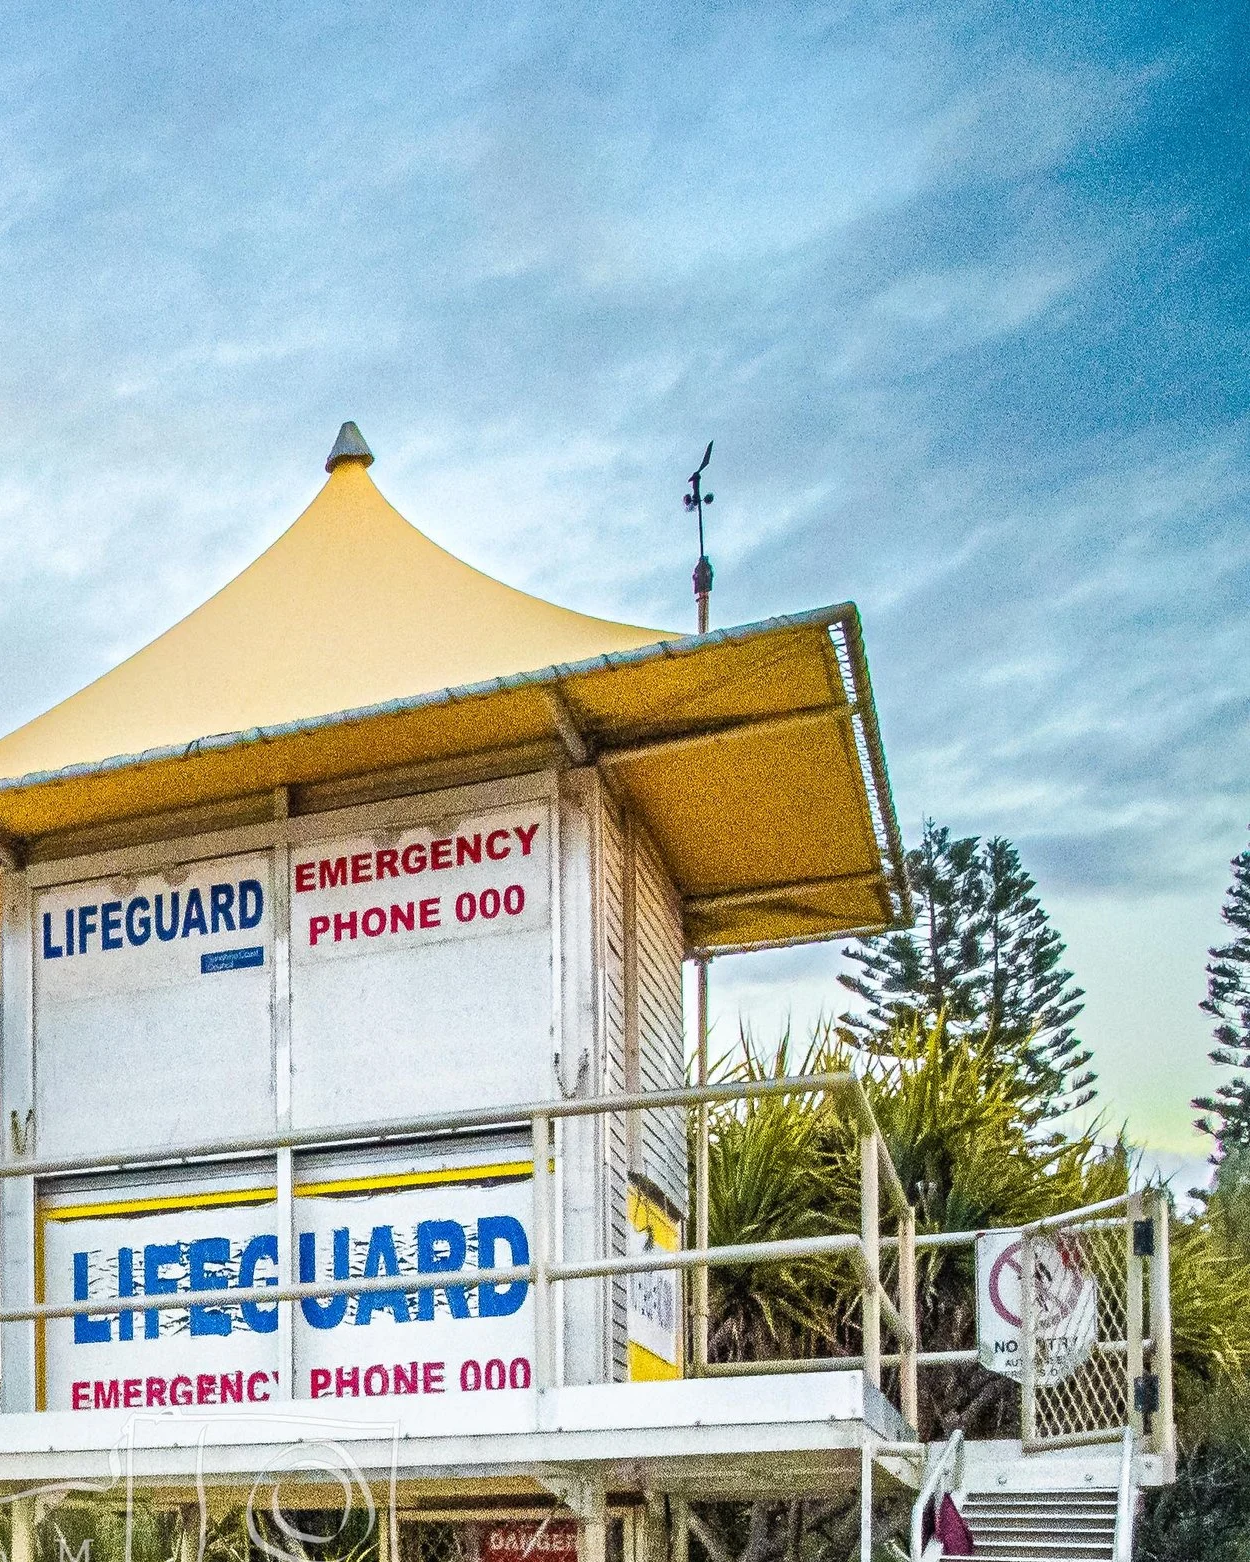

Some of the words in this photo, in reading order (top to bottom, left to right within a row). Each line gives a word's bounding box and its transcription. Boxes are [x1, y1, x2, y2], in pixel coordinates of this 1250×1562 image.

[295, 823, 540, 893] EMERGENCY
[42, 879, 265, 960] LIFEGUARD
[308, 896, 441, 946] PHONE
[454, 884, 527, 923] 000
[73, 1215, 530, 1345] LIFEGUARD
[994, 1340, 1019, 1354] NO
[71, 1370, 280, 1411] EMERGENC
[310, 1361, 446, 1399] PHONE
[459, 1356, 532, 1392] 000
